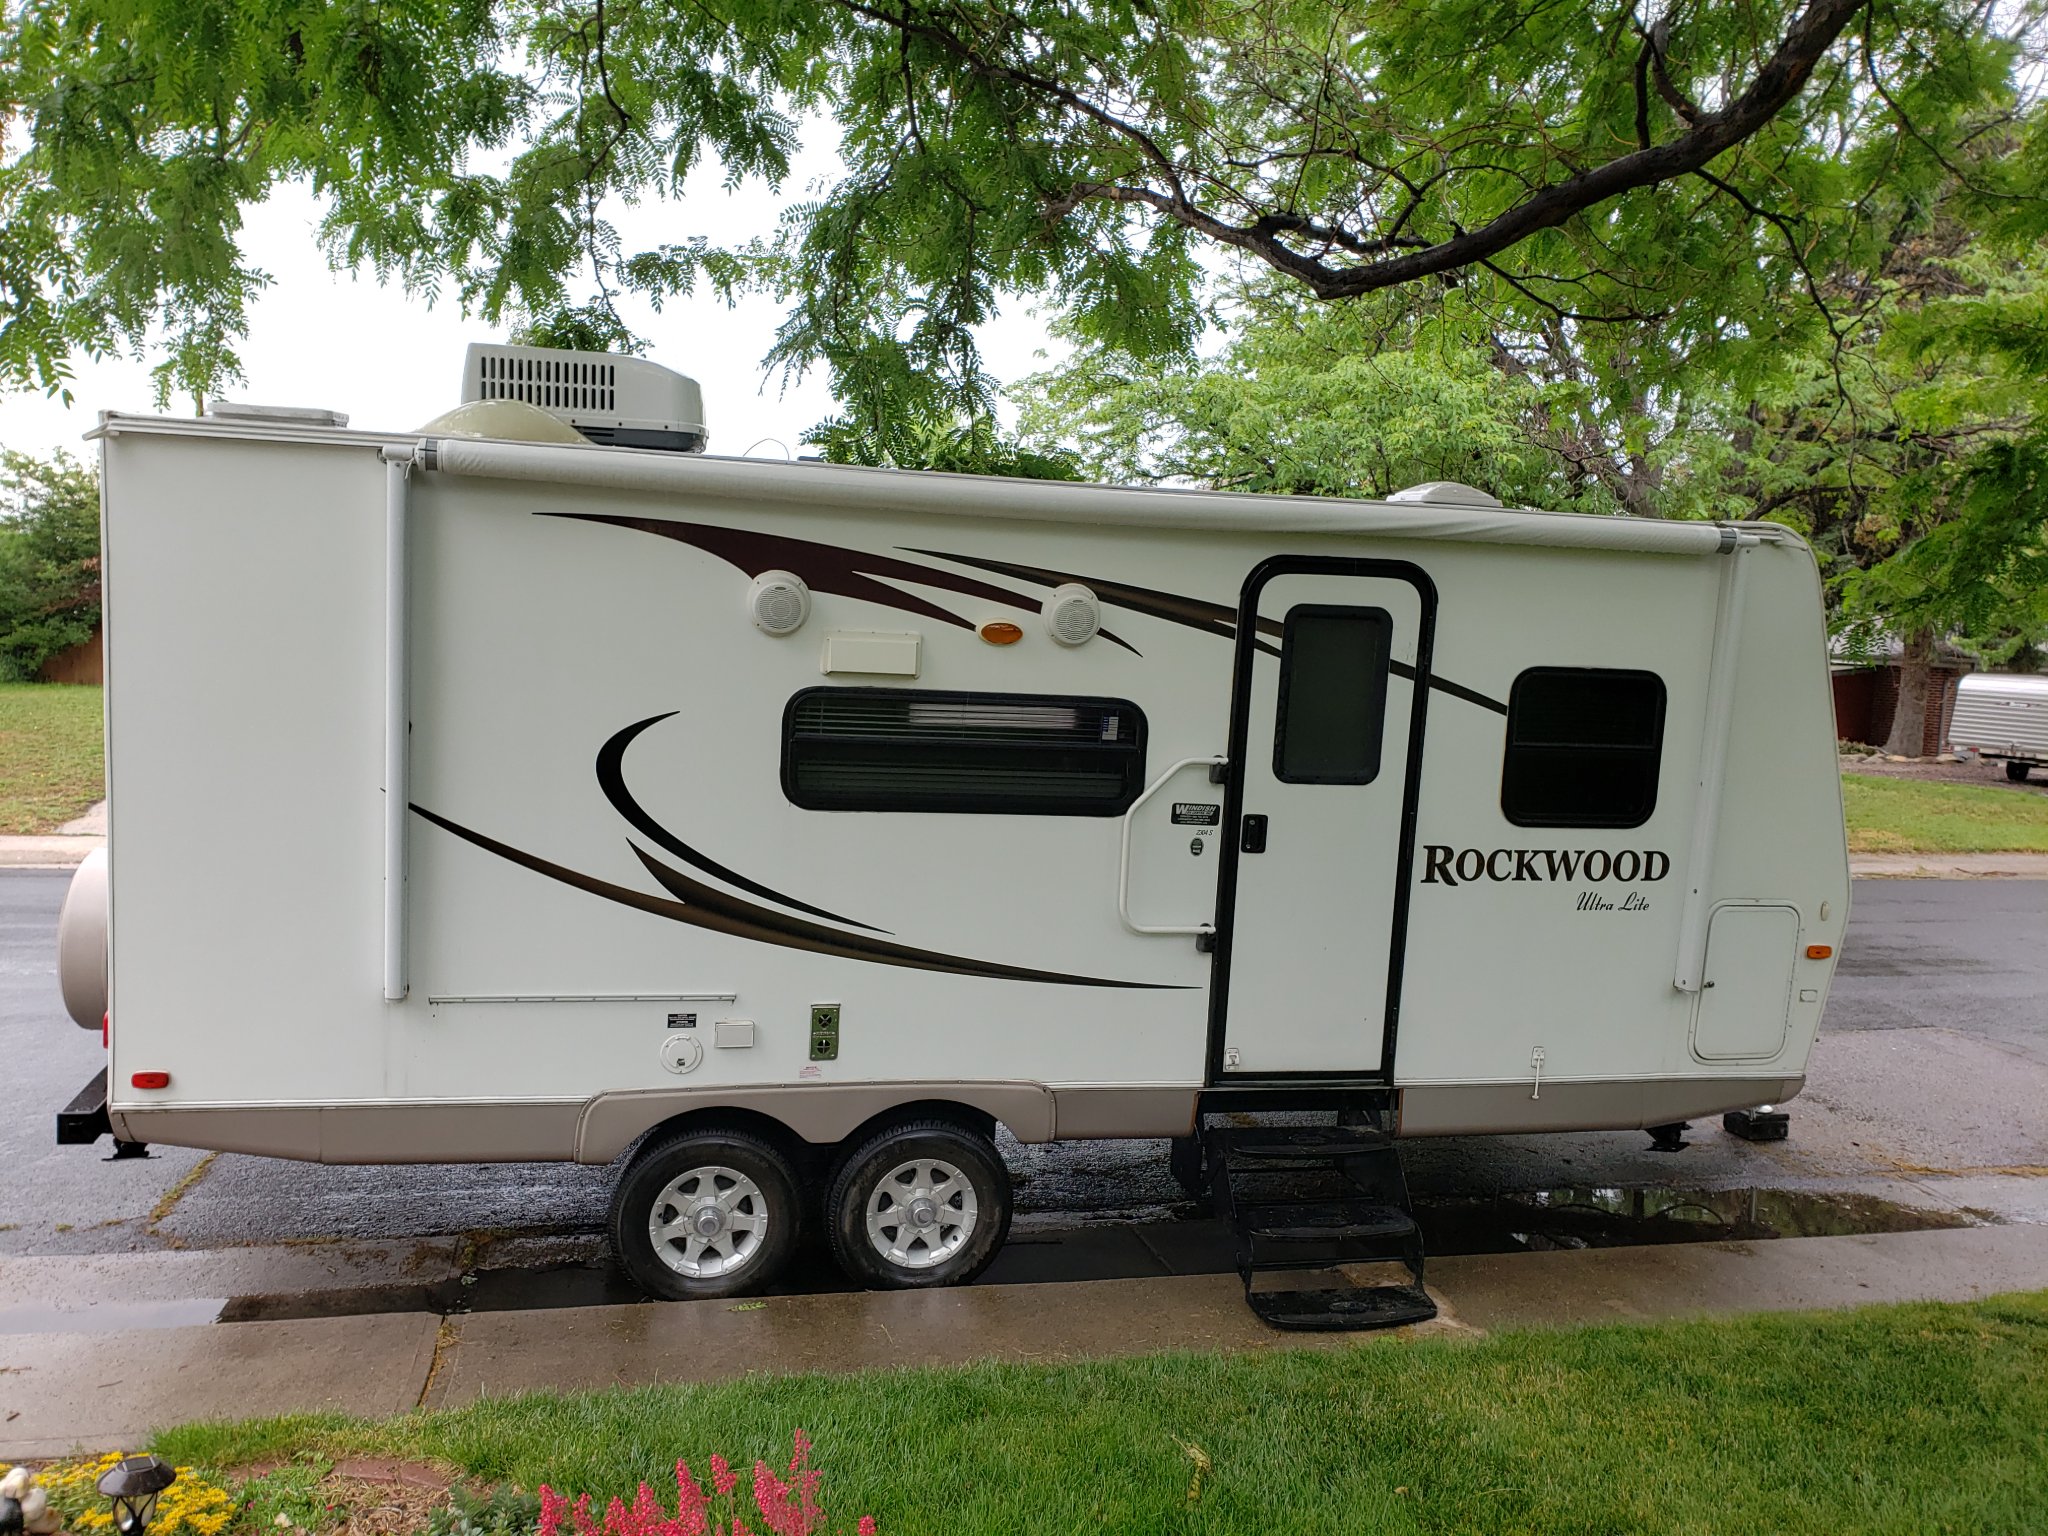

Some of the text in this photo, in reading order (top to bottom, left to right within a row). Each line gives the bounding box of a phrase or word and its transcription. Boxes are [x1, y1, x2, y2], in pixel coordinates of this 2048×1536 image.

[1175, 804, 1217, 815] WINDISH
[1420, 845, 1670, 886] ROCKWOOD
[1576, 891, 1650, 912] Ultra Lite
